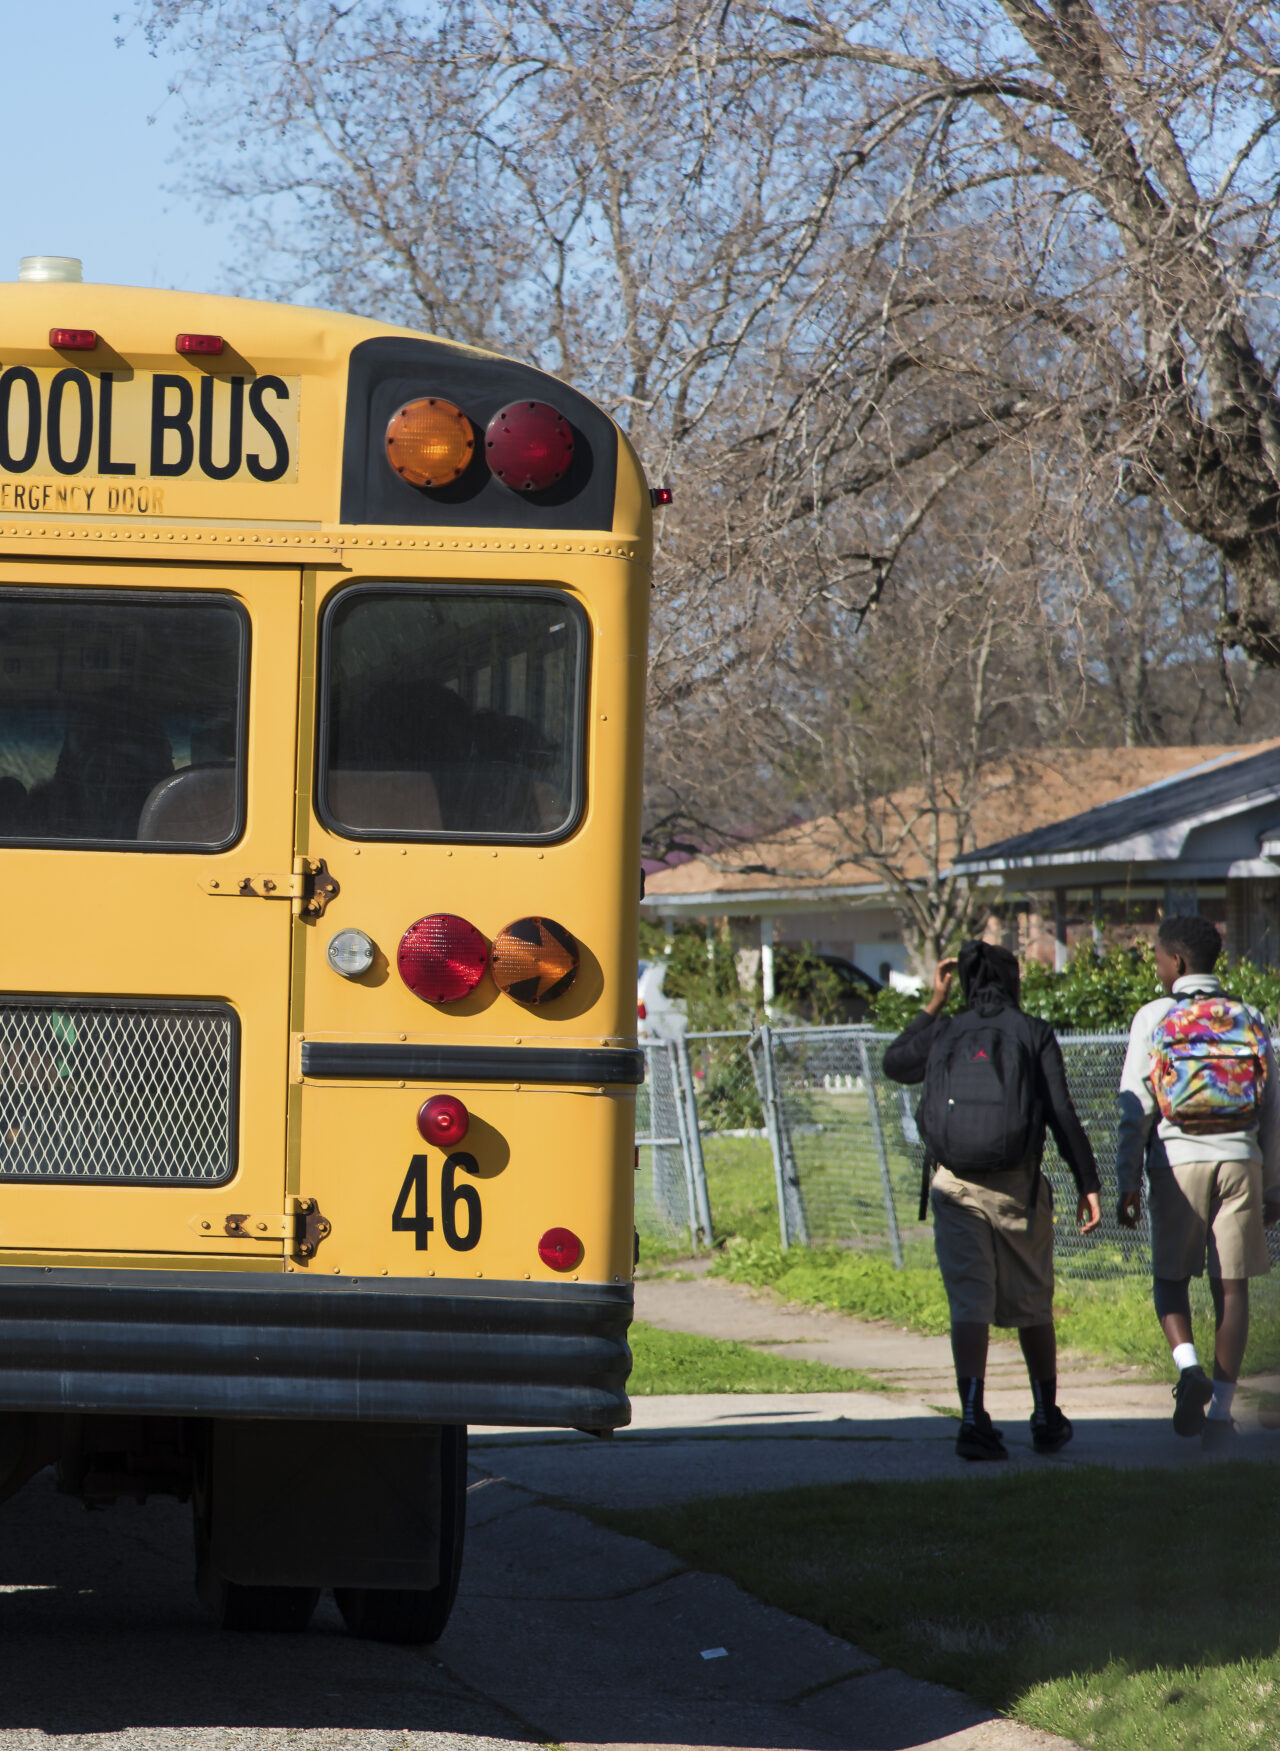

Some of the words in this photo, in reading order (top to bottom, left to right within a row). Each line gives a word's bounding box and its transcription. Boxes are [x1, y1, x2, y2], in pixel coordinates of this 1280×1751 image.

[150, 373, 290, 482] BUS
[108, 485, 165, 514] DOOR
[391, 1151, 483, 1252] 46
